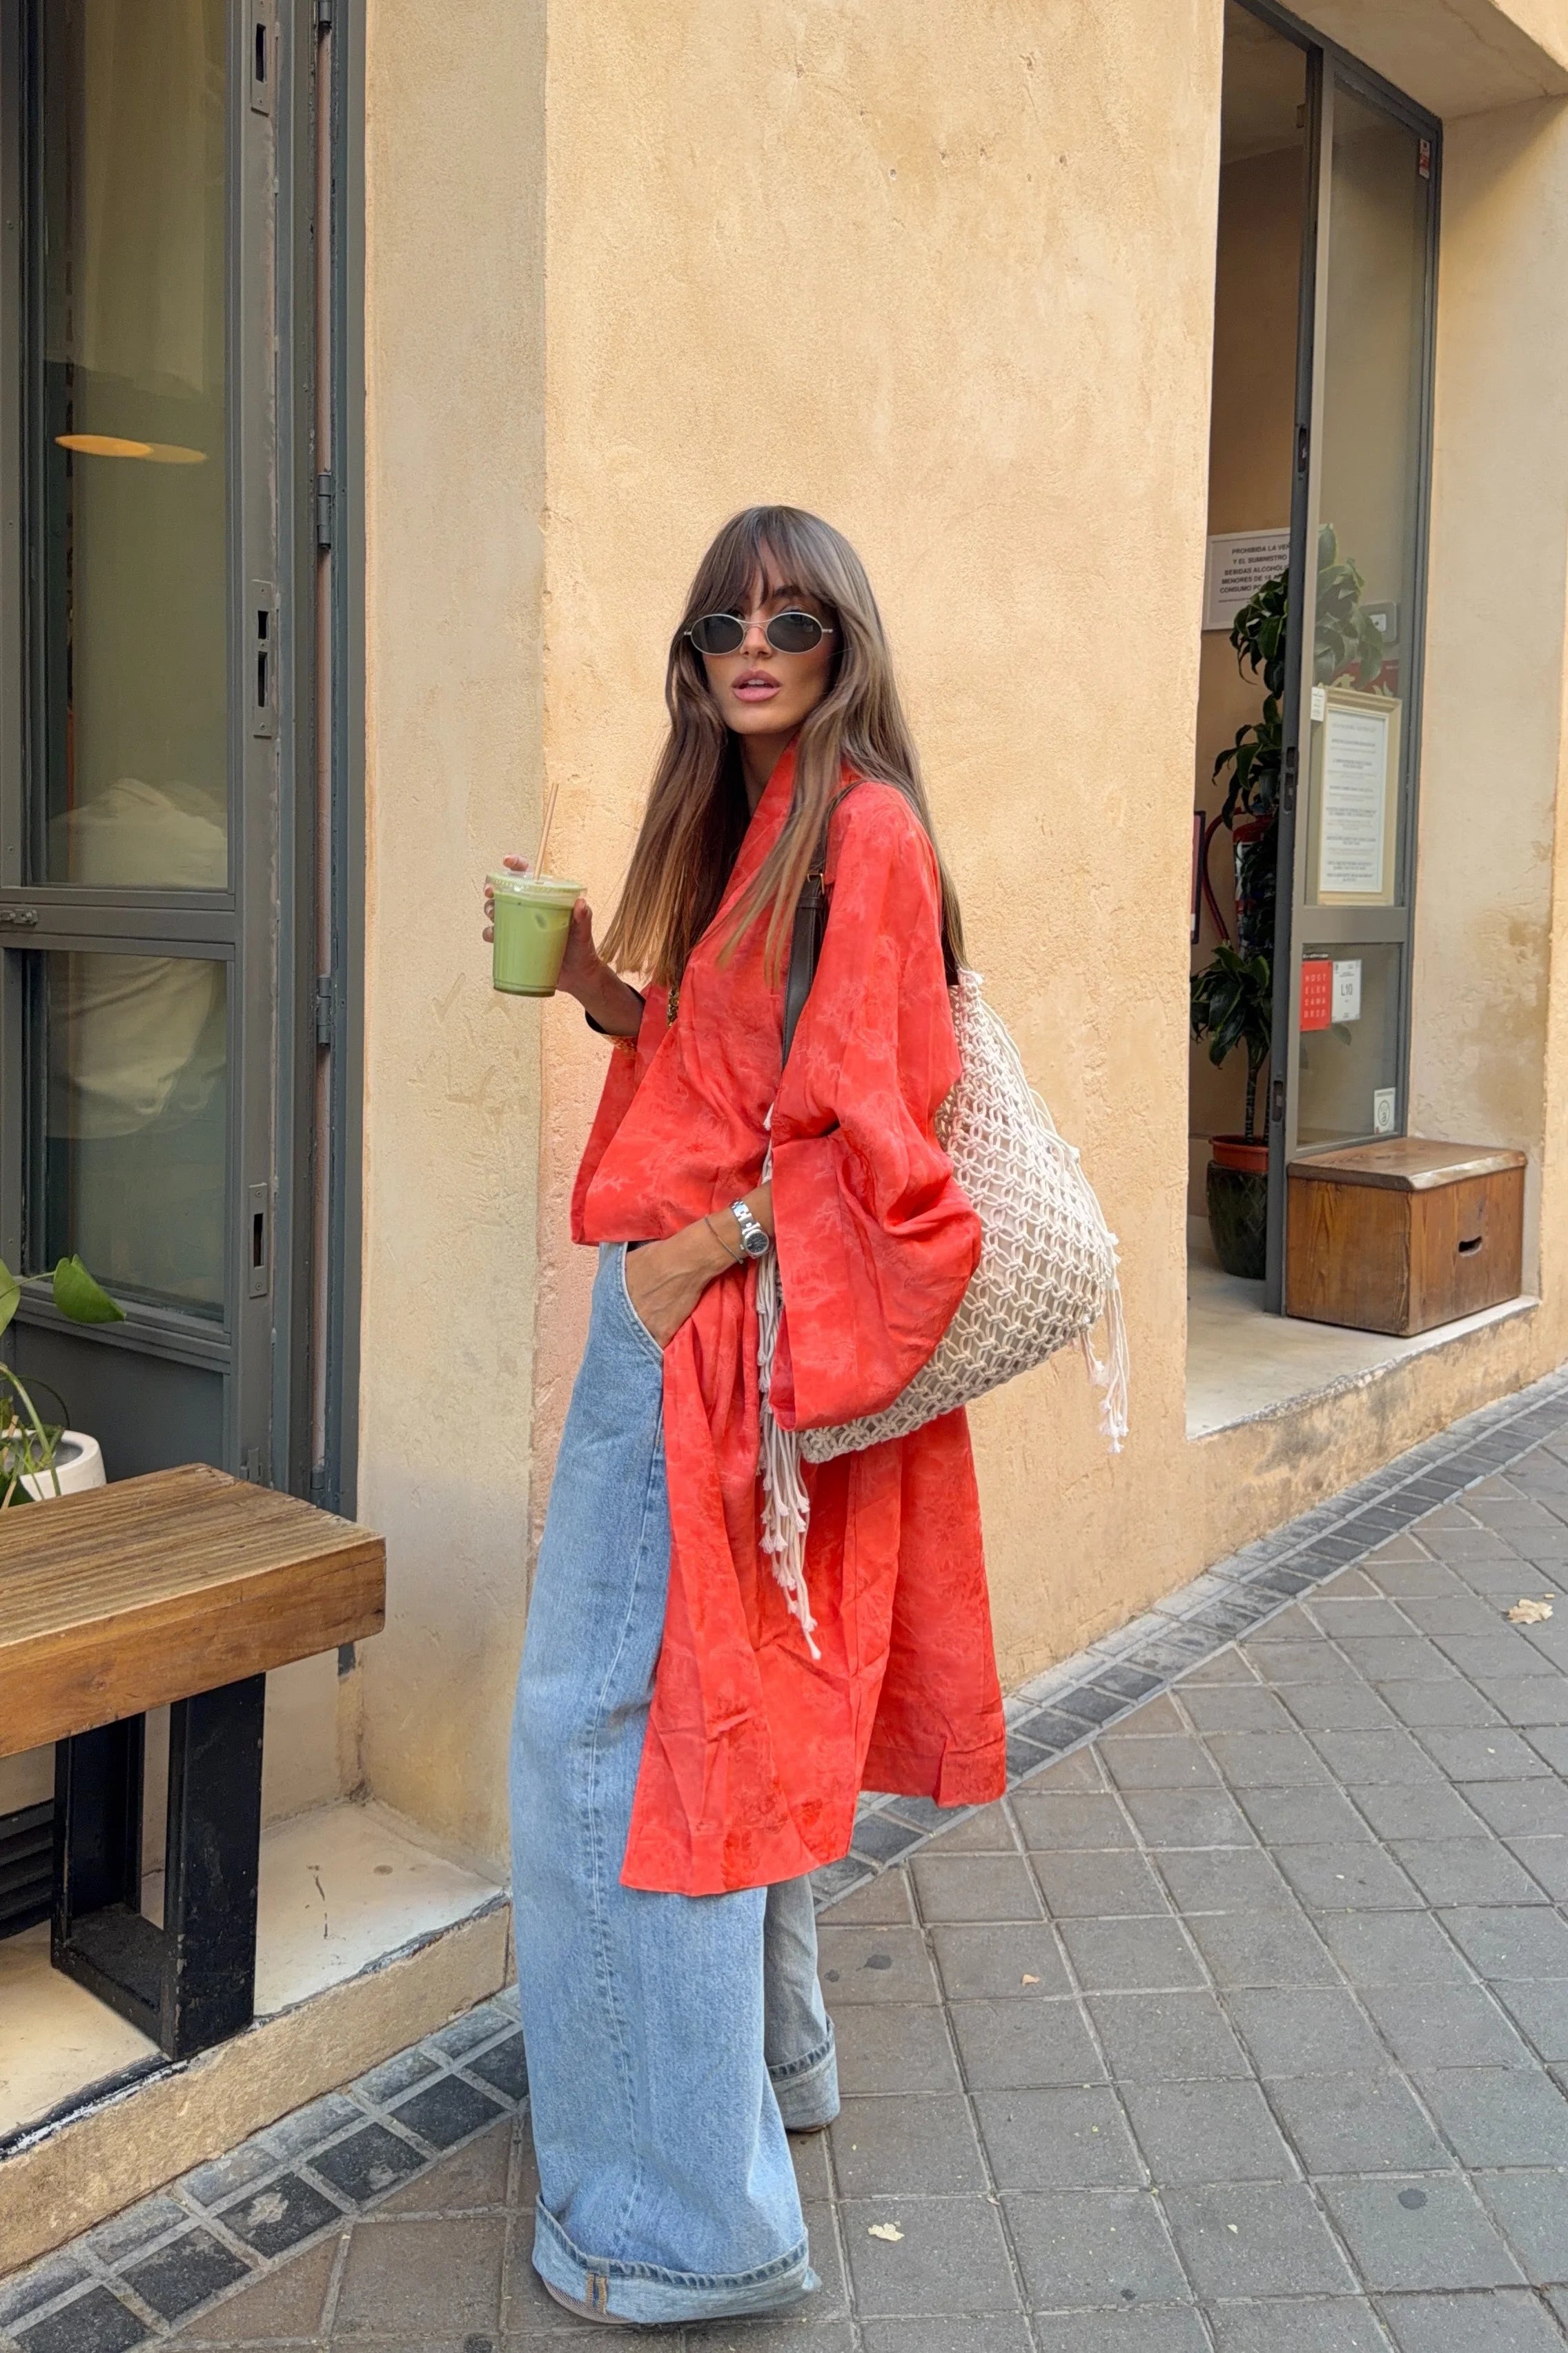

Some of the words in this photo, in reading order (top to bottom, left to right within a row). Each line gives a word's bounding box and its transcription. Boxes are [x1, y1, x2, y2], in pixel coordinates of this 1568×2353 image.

[1232, 546, 1266, 554] PROHIBIDA
[1248, 555, 1287, 563] SUMINISTRO
[1220, 585, 1252, 594] CONSUMO
